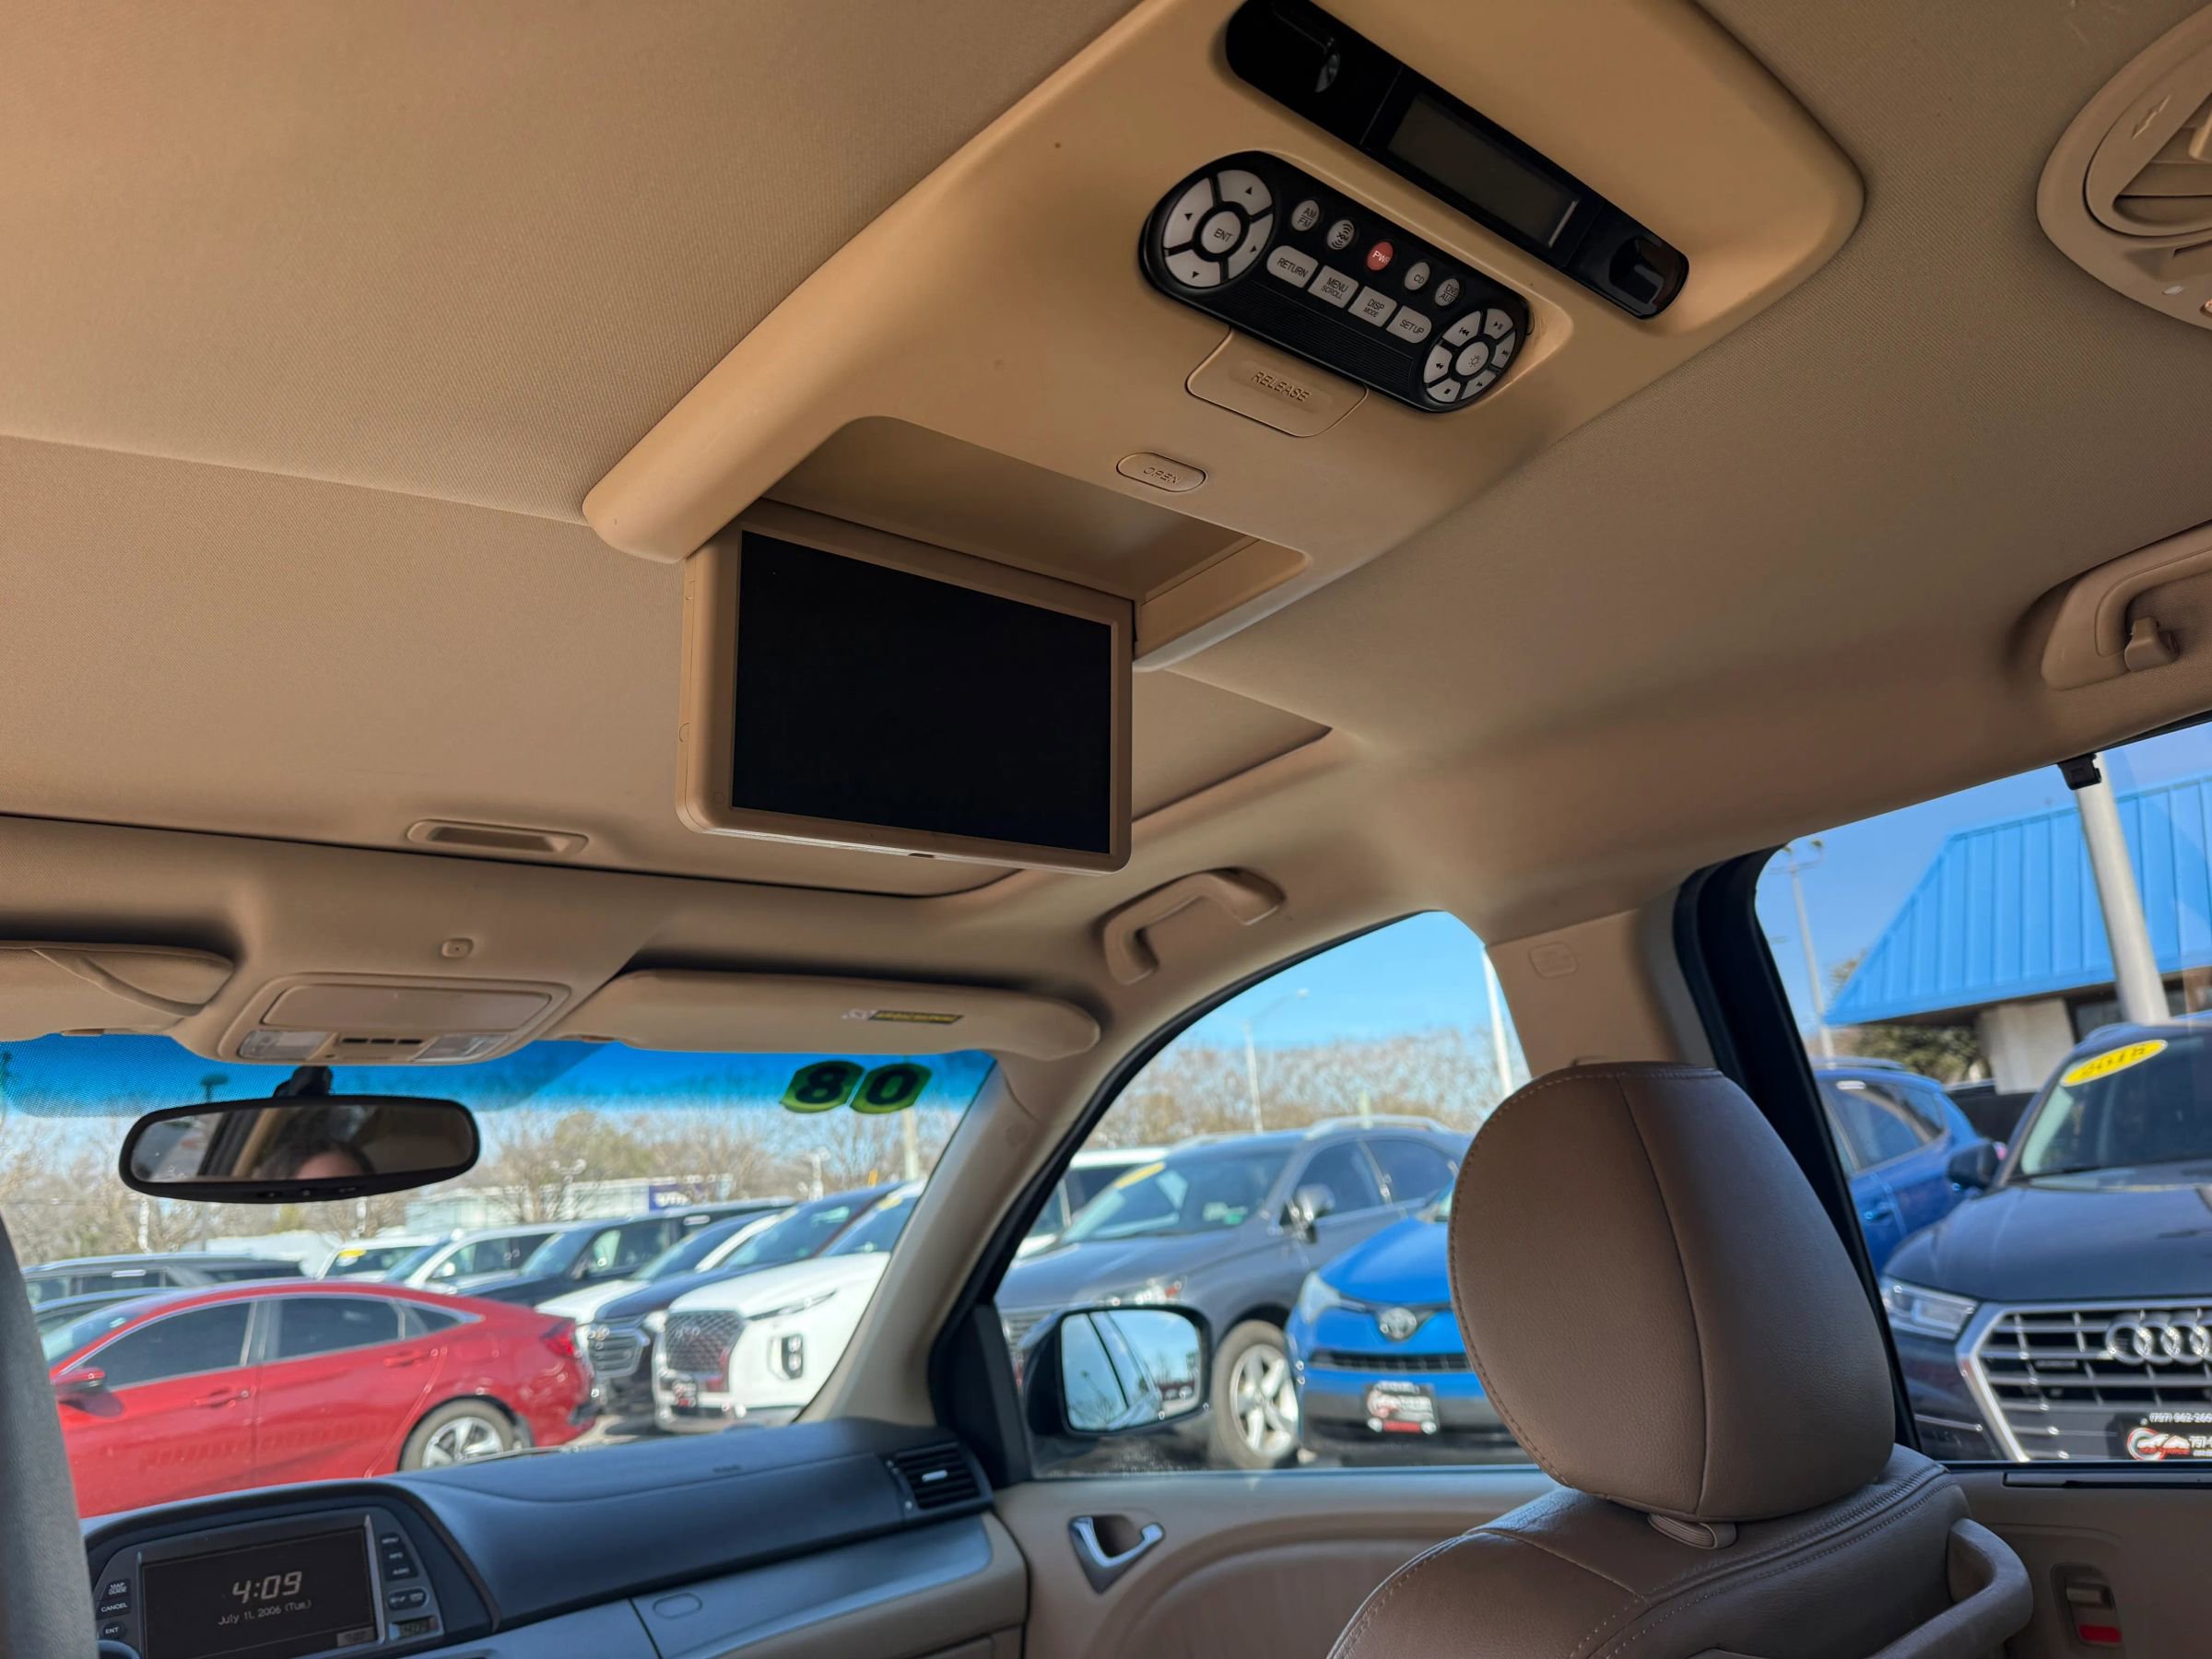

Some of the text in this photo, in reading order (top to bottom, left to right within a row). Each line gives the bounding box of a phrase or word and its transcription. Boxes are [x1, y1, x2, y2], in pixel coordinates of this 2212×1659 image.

[1303, 206, 1318, 219] AM
[1214, 228, 1233, 241] ENT
[1277, 257, 1310, 277] RETURN
[1326, 276, 1349, 292] MENU
[1413, 274, 1425, 285] CD
[1321, 285, 1344, 300] SCROLL
[1367, 298, 1385, 311] DISP
[1363, 306, 1380, 318] MODE
[1251, 371, 1310, 403] RELEASE
[1142, 465, 1182, 485] OPEN
[231, 1571, 303, 1604] 4:09
[100, 1602, 128, 1613] CANCEL
[218, 1614, 241, 1626] July
[257, 1606, 282, 1618] 2006
[105, 1626, 120, 1635] ENT
